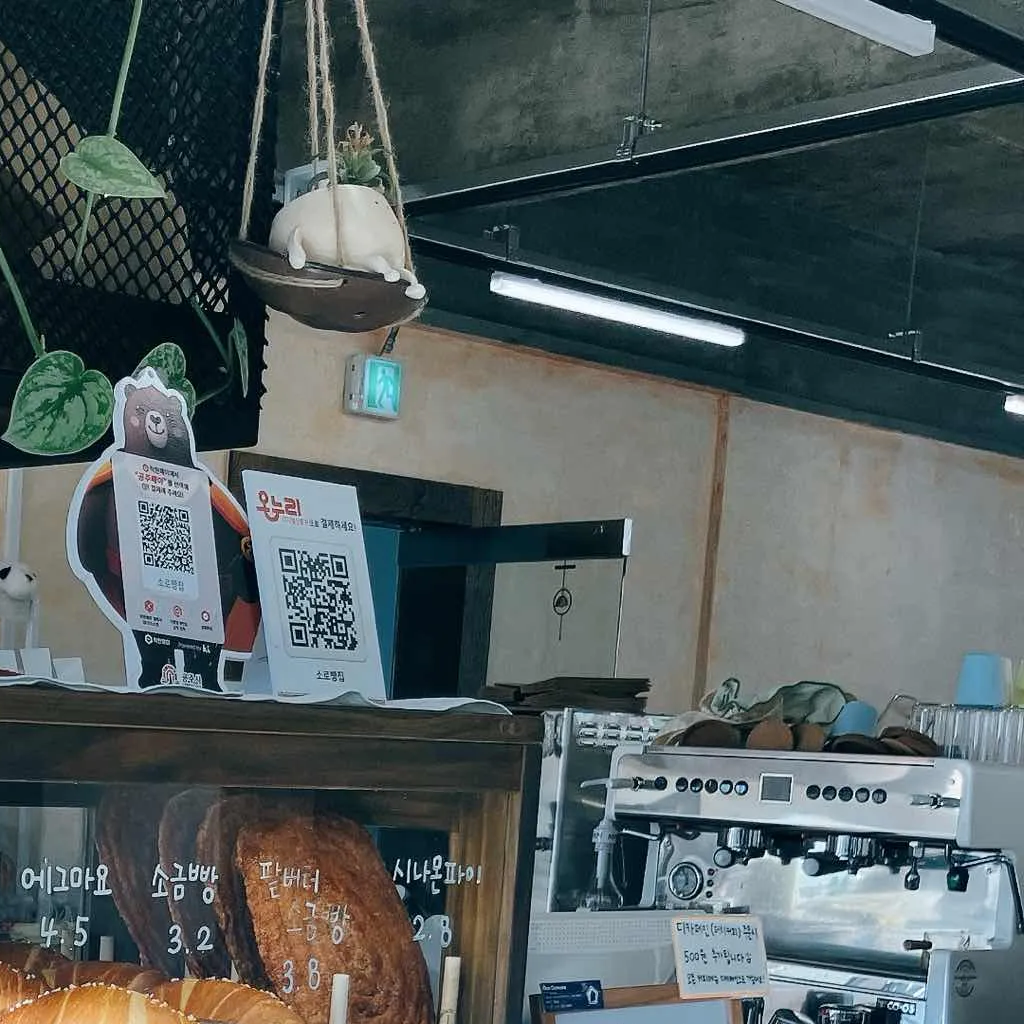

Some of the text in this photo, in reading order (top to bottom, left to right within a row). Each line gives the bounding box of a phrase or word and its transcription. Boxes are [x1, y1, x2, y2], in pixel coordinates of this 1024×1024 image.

[316, 670, 345, 682] 소로빵집
[21, 863, 113, 896] 에그마요
[151, 862, 219, 904] 소금빵
[259, 861, 320, 899] 팥버터
[392, 854, 482, 895] 시나몬파이
[40, 915, 89, 948] 4.5
[167, 924, 214, 955] 3.2
[412, 914, 452, 948] 2.8
